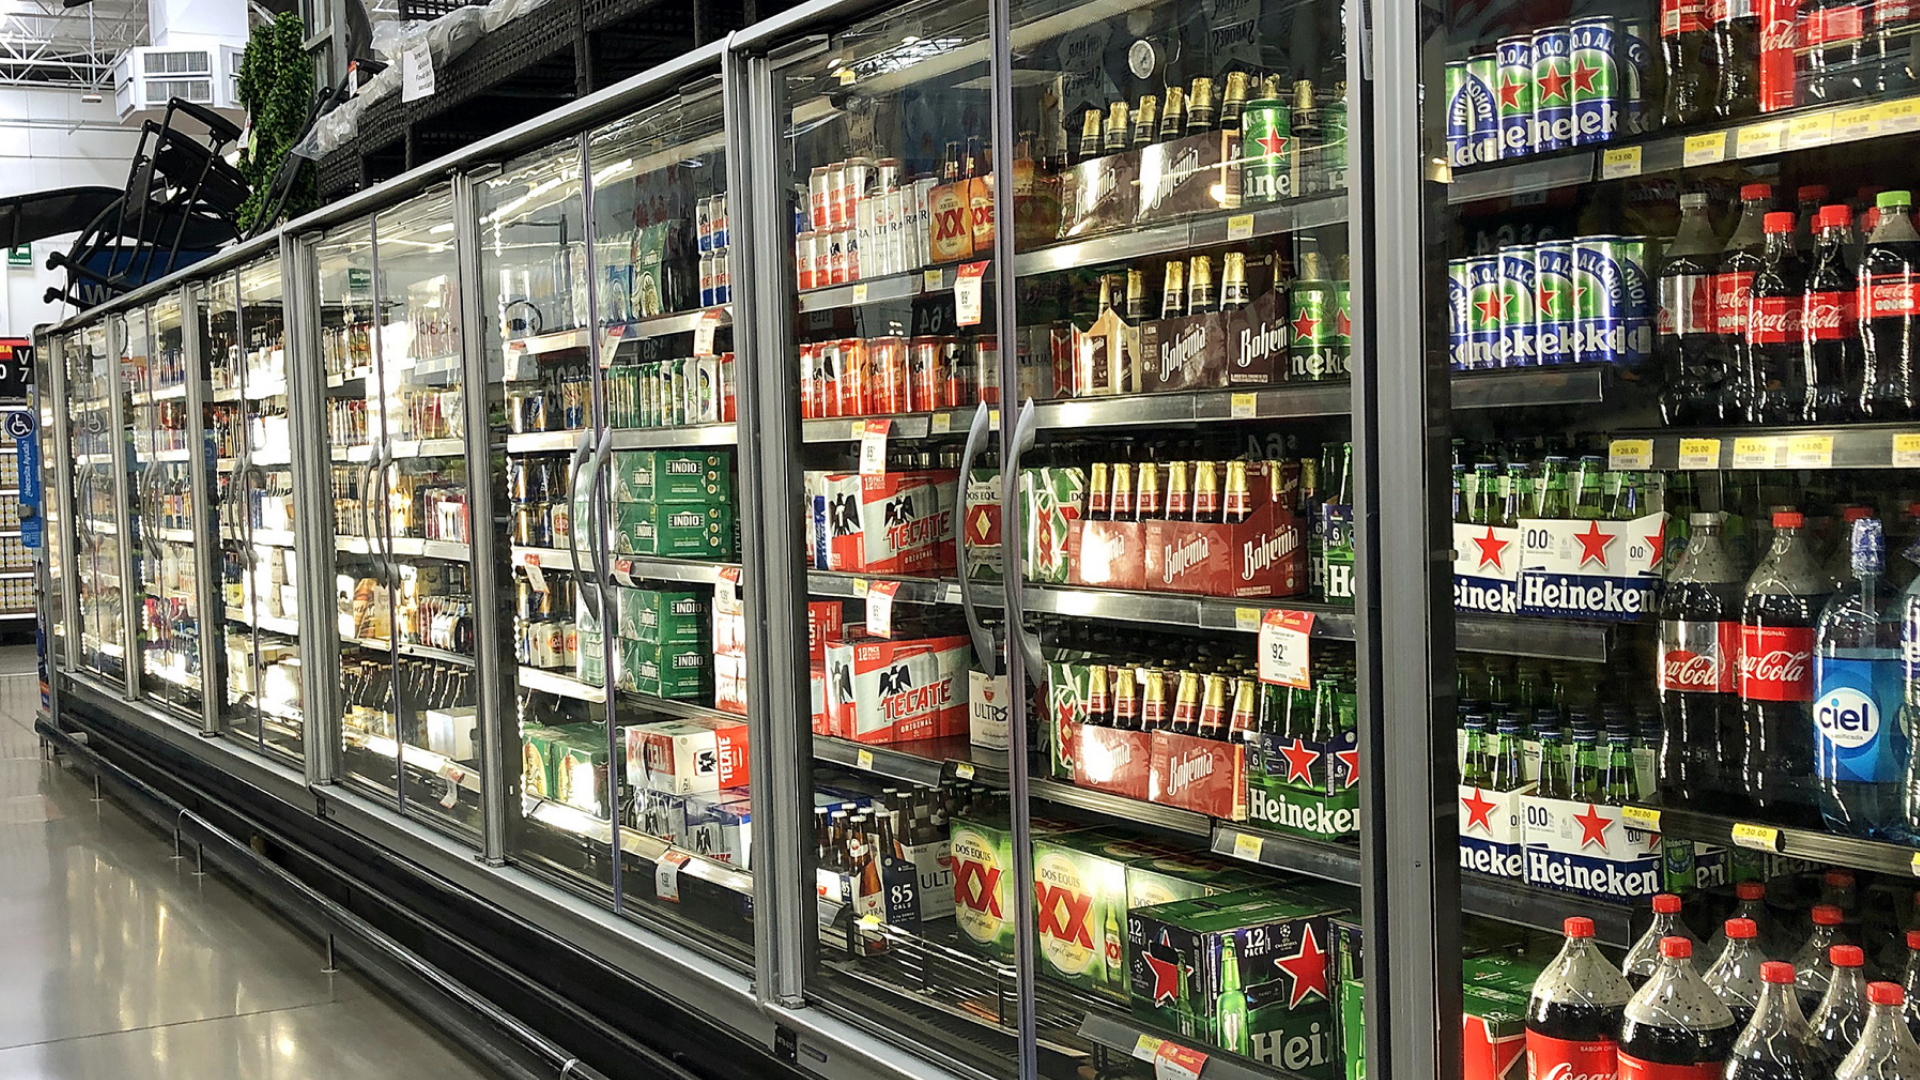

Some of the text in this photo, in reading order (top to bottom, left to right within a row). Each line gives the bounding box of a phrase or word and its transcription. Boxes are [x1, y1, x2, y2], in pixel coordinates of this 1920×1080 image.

[934, 207, 966, 241] XX
[17, 349, 30, 365] V
[1160, 324, 1207, 383] Bohemia
[19, 367, 30, 383] 7
[671, 462, 697, 474] INDIO
[673, 515, 699, 526] INDIO
[887, 510, 951, 551] TECATE
[1332, 527, 1340, 541] 6
[1527, 529, 1548, 550] 0.0
[1163, 534, 1210, 584] Bohemia
[1241, 525, 1300, 582] Bohemia
[1523, 575, 1656, 613] Heineken
[676, 602, 701, 614] INDIO
[678, 655, 704, 667] INDIO
[880, 677, 953, 720] TECATE
[900, 718, 932, 733] ORIGINAL
[1819, 698, 1870, 732] ciel
[718, 736, 733, 783] TECATE
[1167, 749, 1214, 796] Bohemia
[1527, 805, 1548, 827] 0.0
[955, 843, 992, 862] DOS EQUIS
[1041, 867, 1081, 888] DOS EQUIS
[1528, 850, 1661, 897] Heineken
[891, 883, 914, 905] 85
[1128, 918, 1142, 937] 12
[1128, 935, 1142, 947] PACK
[1245, 928, 1265, 949] 12
[1244, 946, 1265, 958] PACK
